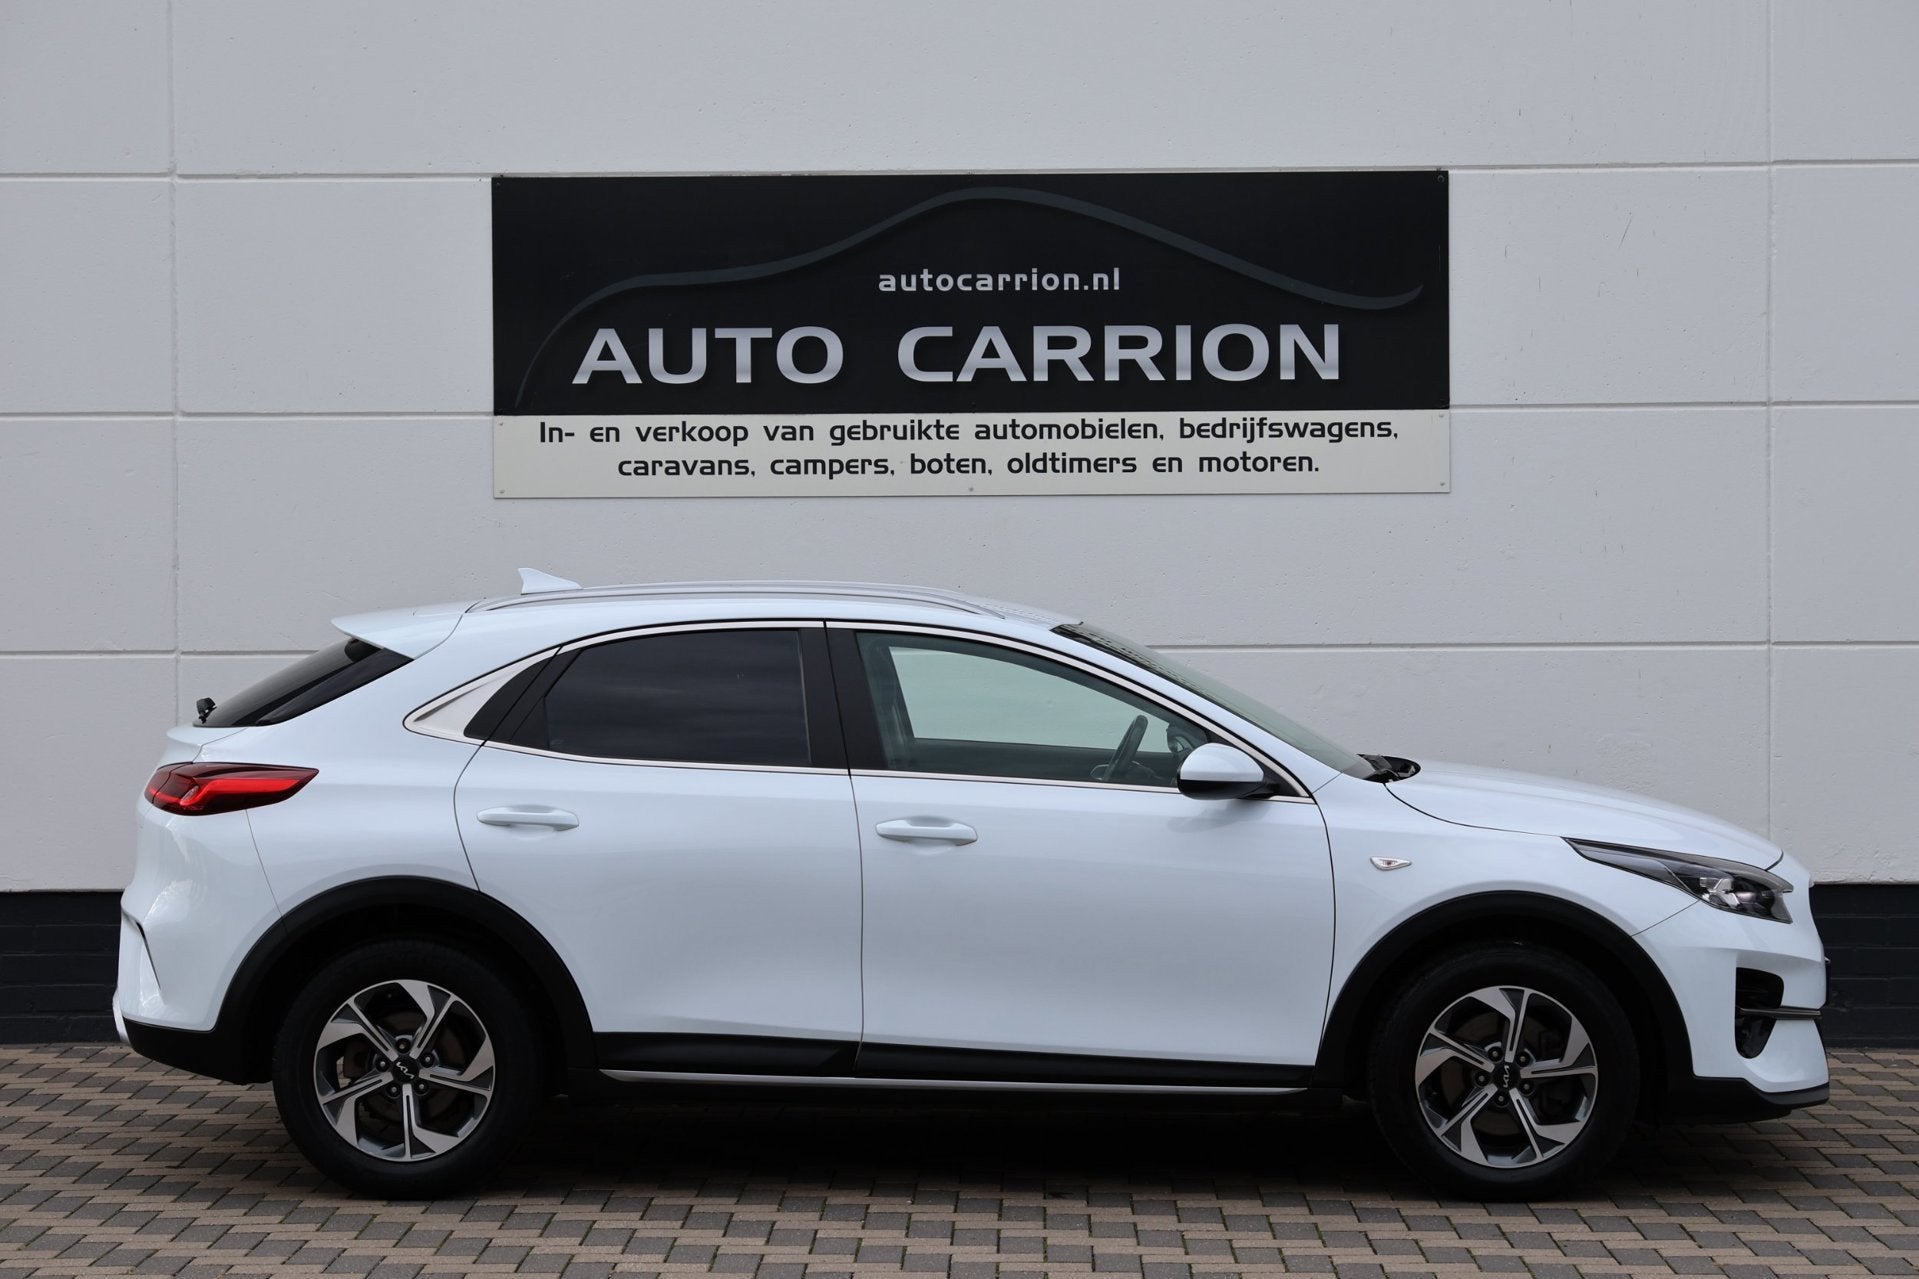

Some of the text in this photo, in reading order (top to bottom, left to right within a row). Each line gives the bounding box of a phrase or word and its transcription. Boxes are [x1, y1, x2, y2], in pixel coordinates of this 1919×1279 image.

[878, 267, 1120, 292] autocarrion.nl
[571, 323, 1340, 385] AUTO CARRION
[540, 416, 1398, 447] In- en verkoop van gebruikte automobielen, bedrijfswagens,
[617, 451, 1319, 480] caravans, campers, boten, oldtimers en motoren.
